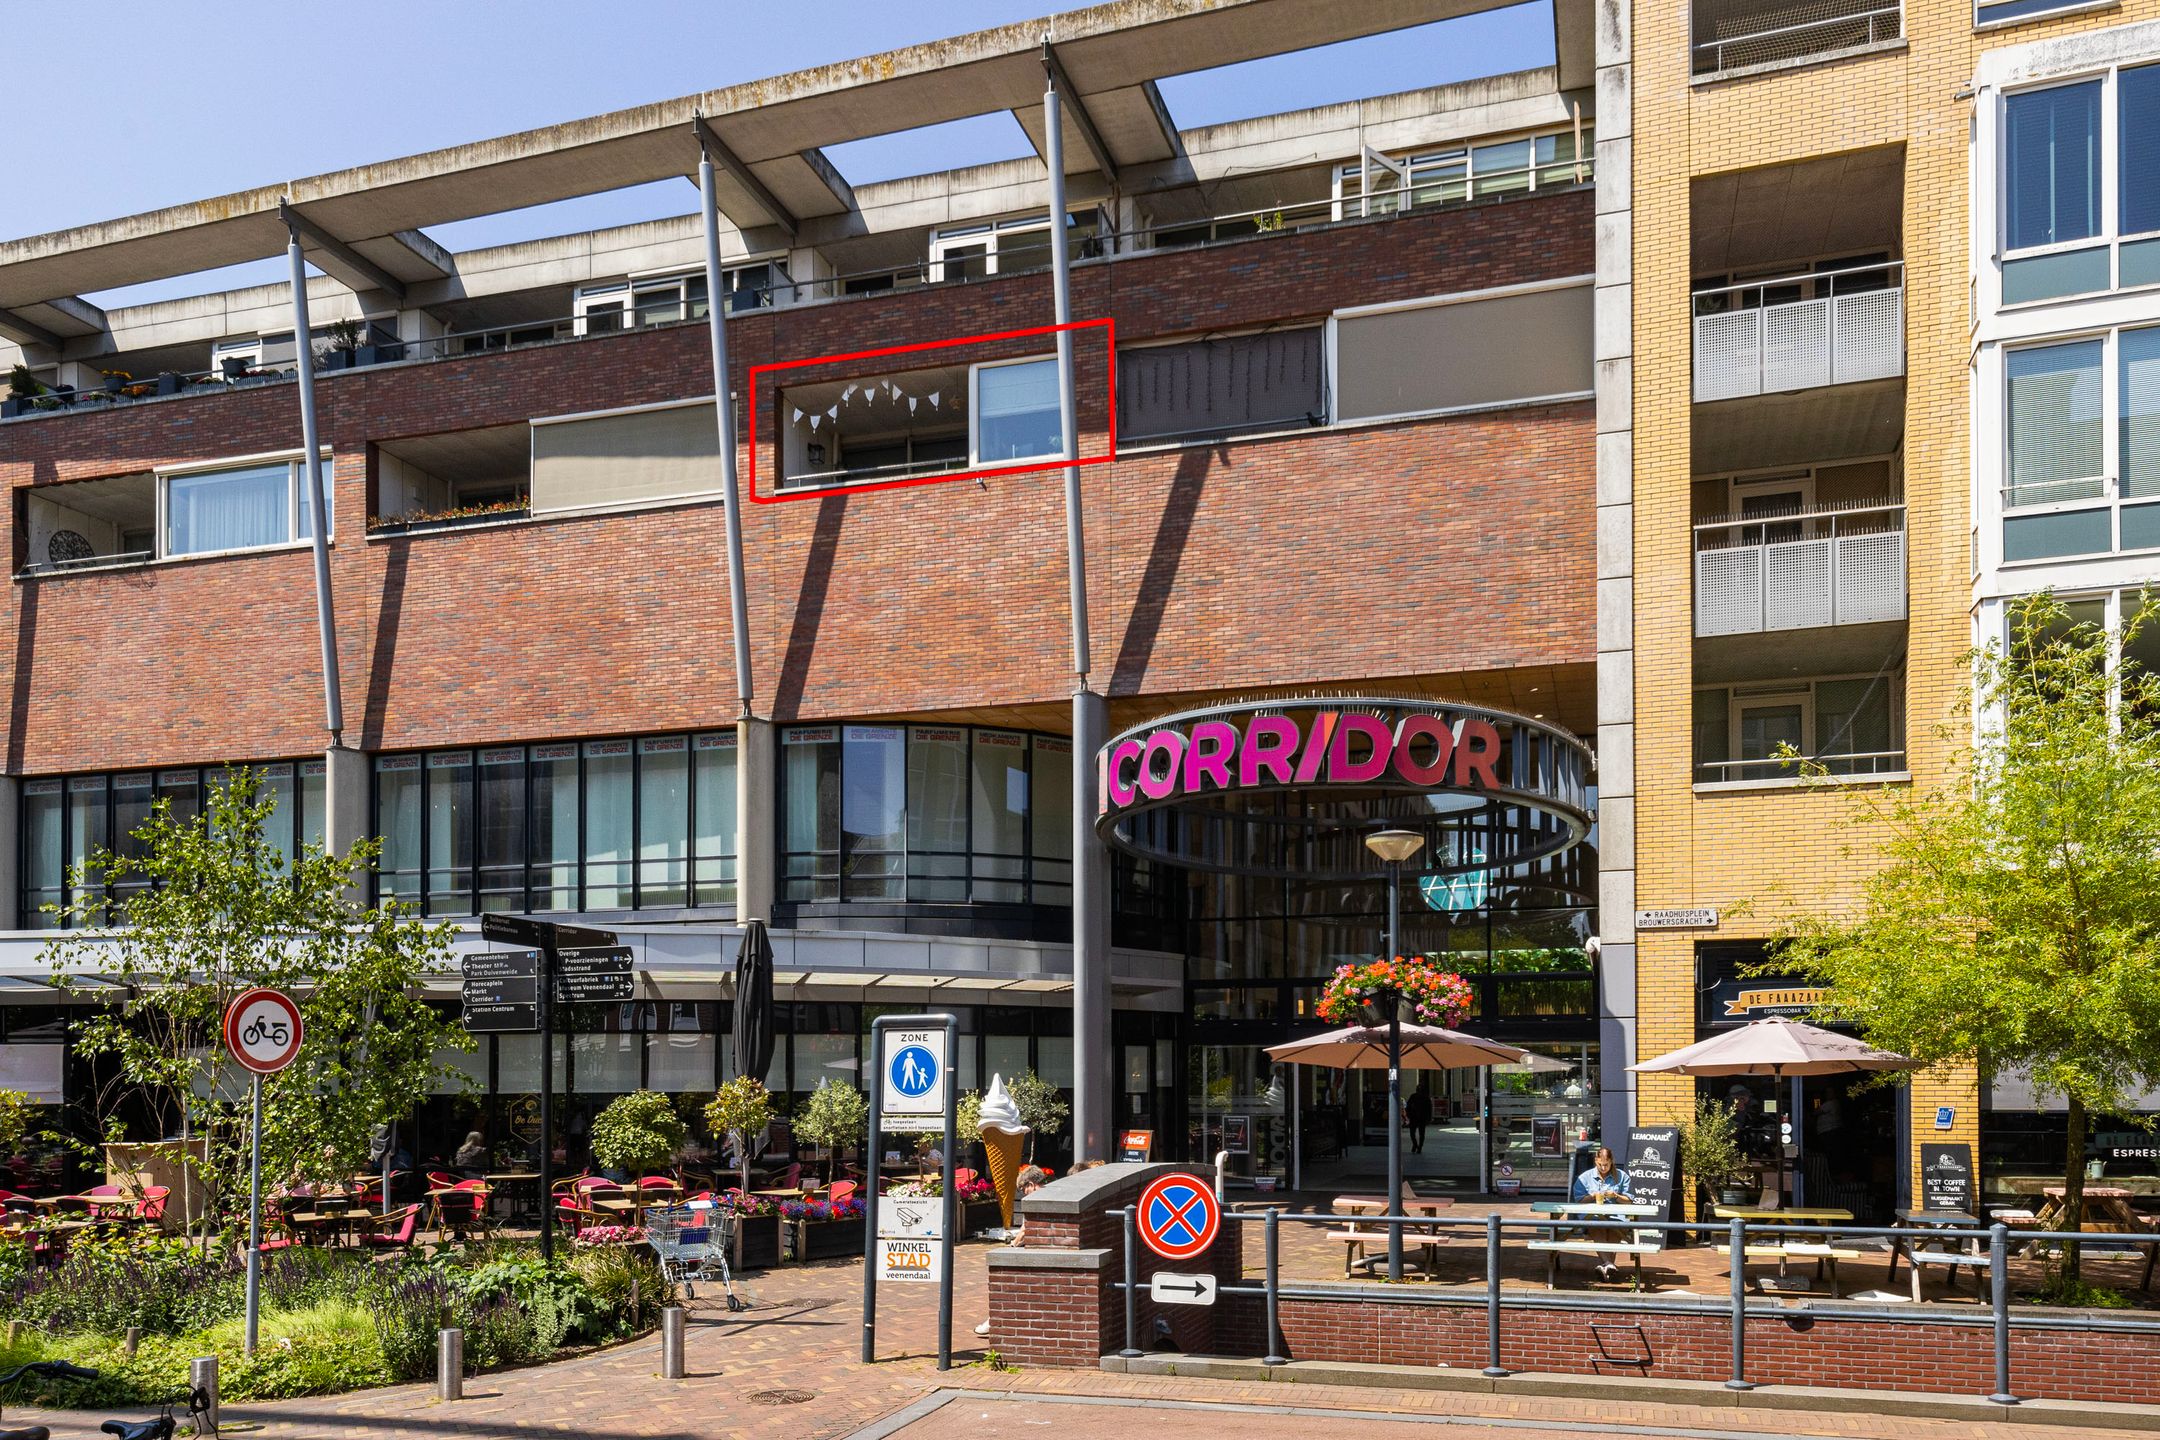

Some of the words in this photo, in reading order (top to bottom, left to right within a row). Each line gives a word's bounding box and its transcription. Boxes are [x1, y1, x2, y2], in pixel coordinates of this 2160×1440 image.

[1109, 711, 1500, 808] CORRIDOR
[1654, 910, 1710, 918] RAADHUISPLEIN
[1639, 918, 1702, 926] BROUWERSGRACHT
[565, 956, 608, 964] P-voorzieningen
[1749, 994, 1761, 1004] DE
[1628, 1170, 1670, 1180] WELCOME!
[1634, 1188, 1658, 1196] WE'VE
[1650, 1198, 1667, 1208] YOU!
[887, 1242, 931, 1252] WINKEL
[887, 1253, 931, 1268] STAD
